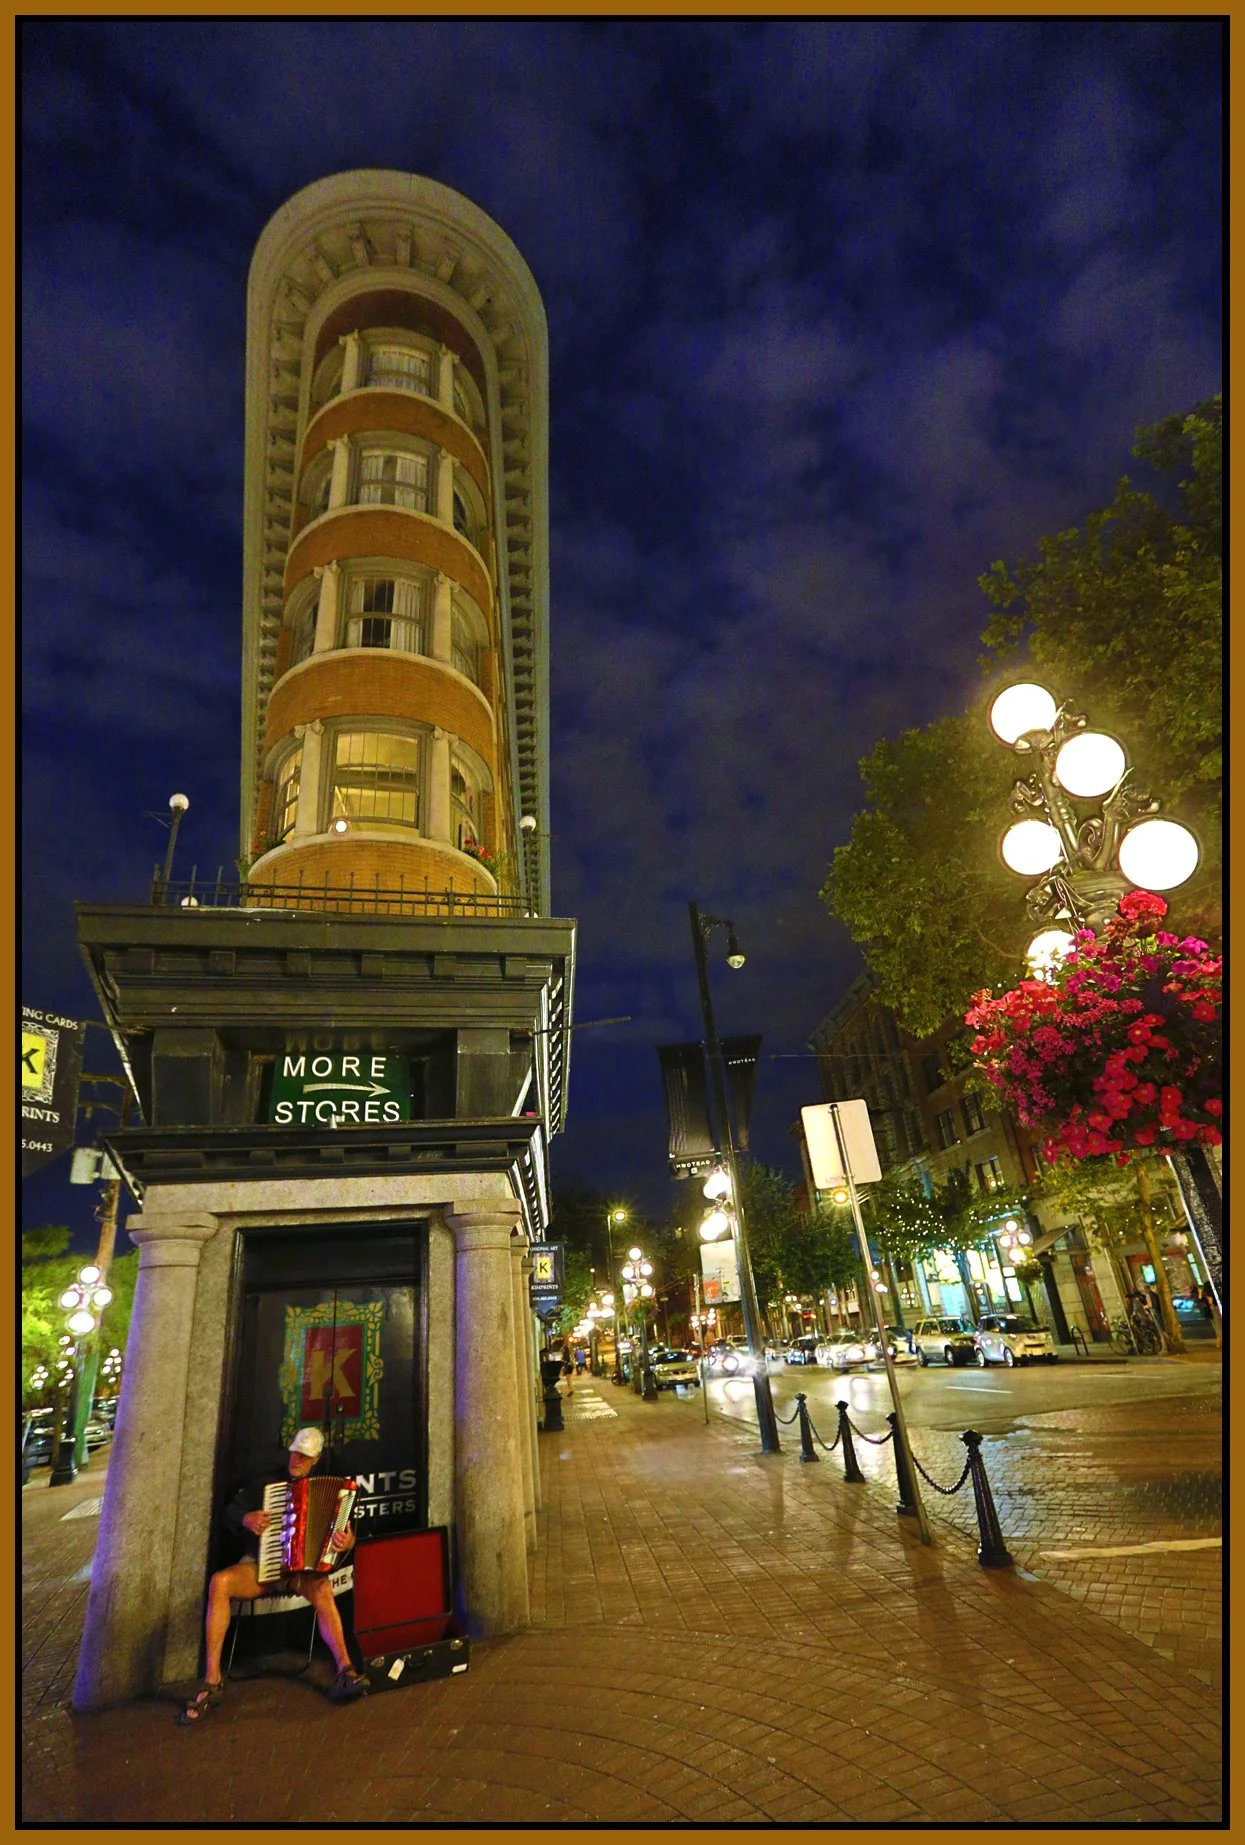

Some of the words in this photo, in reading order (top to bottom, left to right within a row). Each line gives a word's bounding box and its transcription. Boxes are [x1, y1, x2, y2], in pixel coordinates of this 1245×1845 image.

[45, 1014, 78, 1031] CARDS
[283, 1056, 386, 1077] MORE
[274, 1100, 400, 1123] STORES
[539, 1262, 548, 1273] K
[309, 1348, 357, 1400] K
